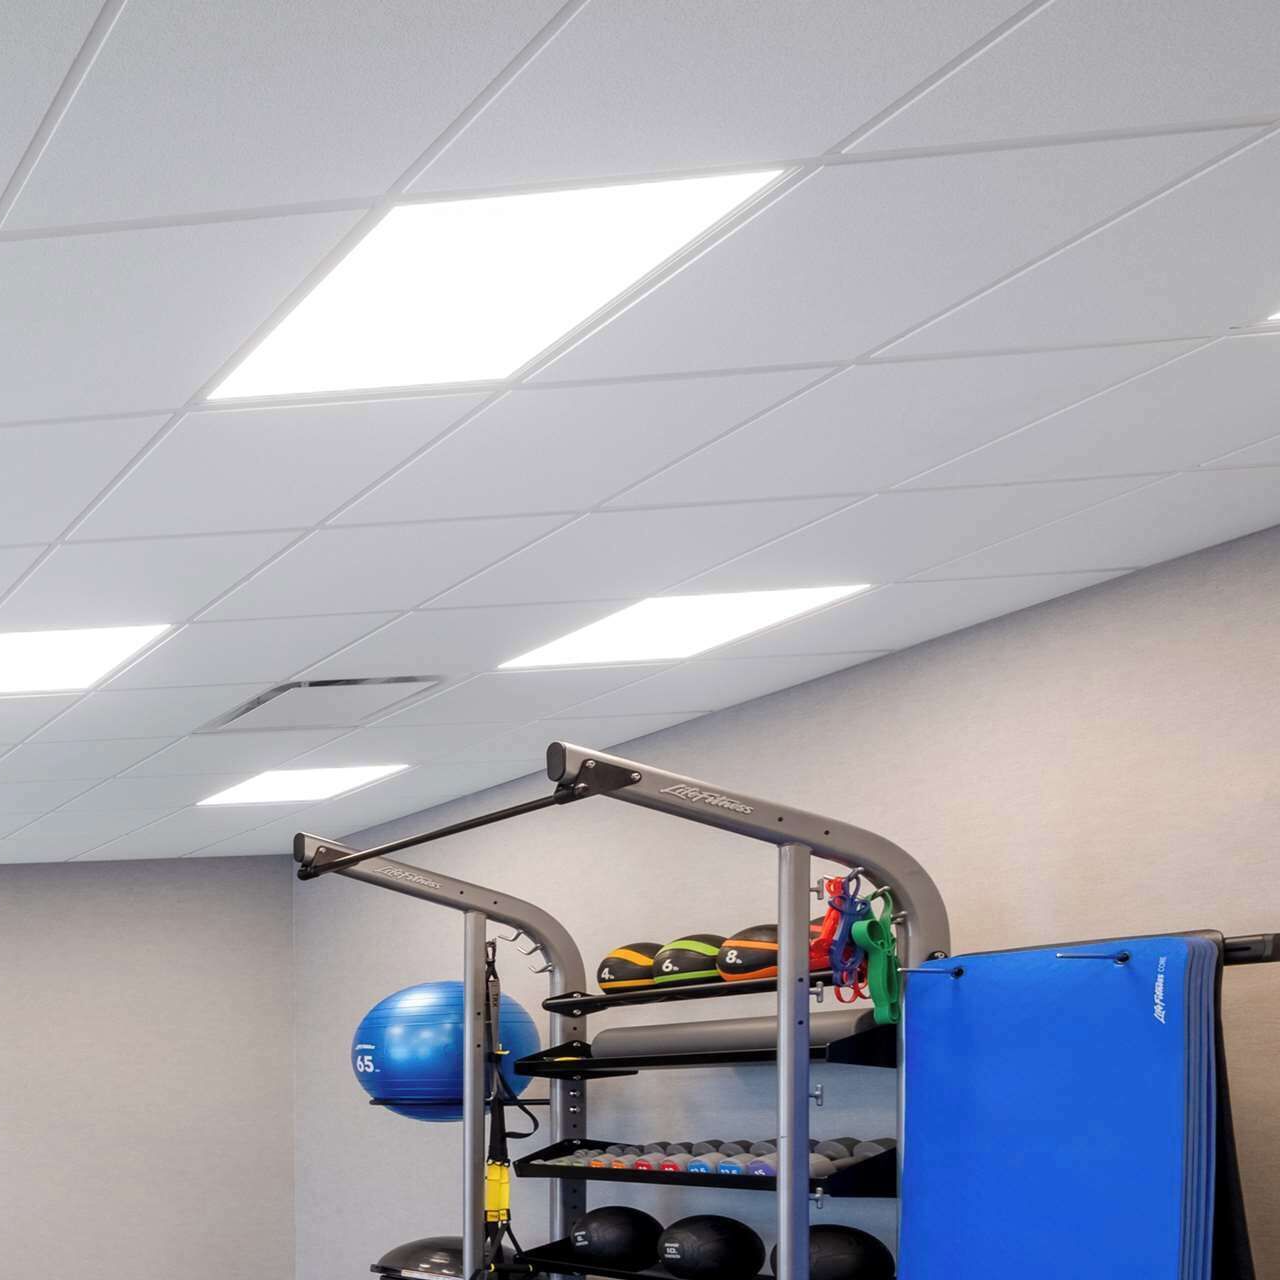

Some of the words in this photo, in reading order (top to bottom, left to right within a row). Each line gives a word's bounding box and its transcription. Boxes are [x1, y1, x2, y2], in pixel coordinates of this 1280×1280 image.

[660, 784, 699, 800] Life
[691, 791, 754, 814] Fitness
[725, 950, 738, 963] 8
[662, 959, 673, 972] 6
[601, 967, 610, 980] 4
[356, 1055, 375, 1072] 65
